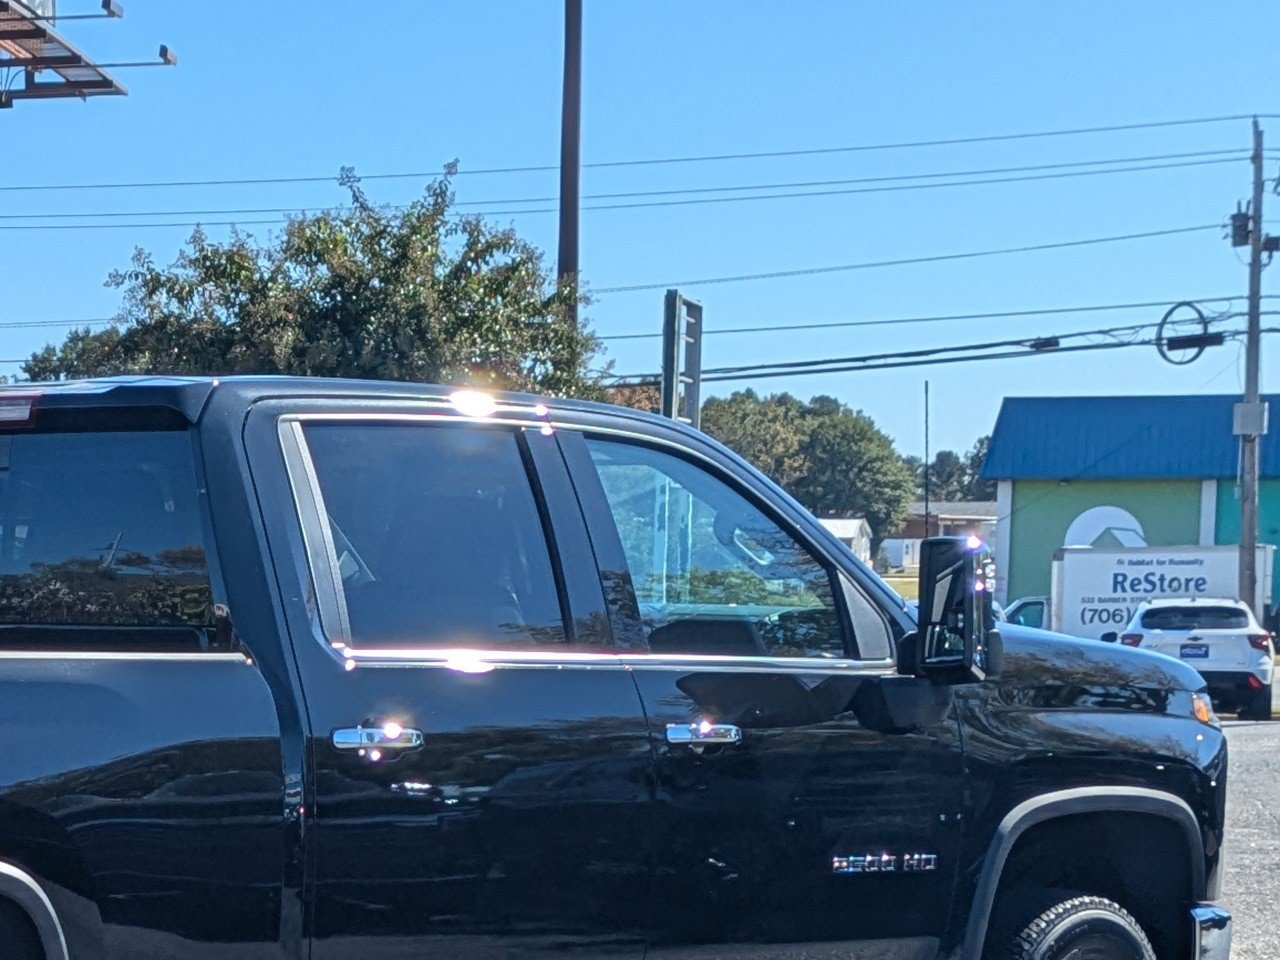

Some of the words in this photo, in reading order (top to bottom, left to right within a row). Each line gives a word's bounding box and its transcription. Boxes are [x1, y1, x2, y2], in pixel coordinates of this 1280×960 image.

[1156, 558, 1166, 566] for
[1168, 558, 1204, 567] Humanity
[1112, 572, 1207, 594] ReStore
[1080, 606, 1132, 625] (706)
